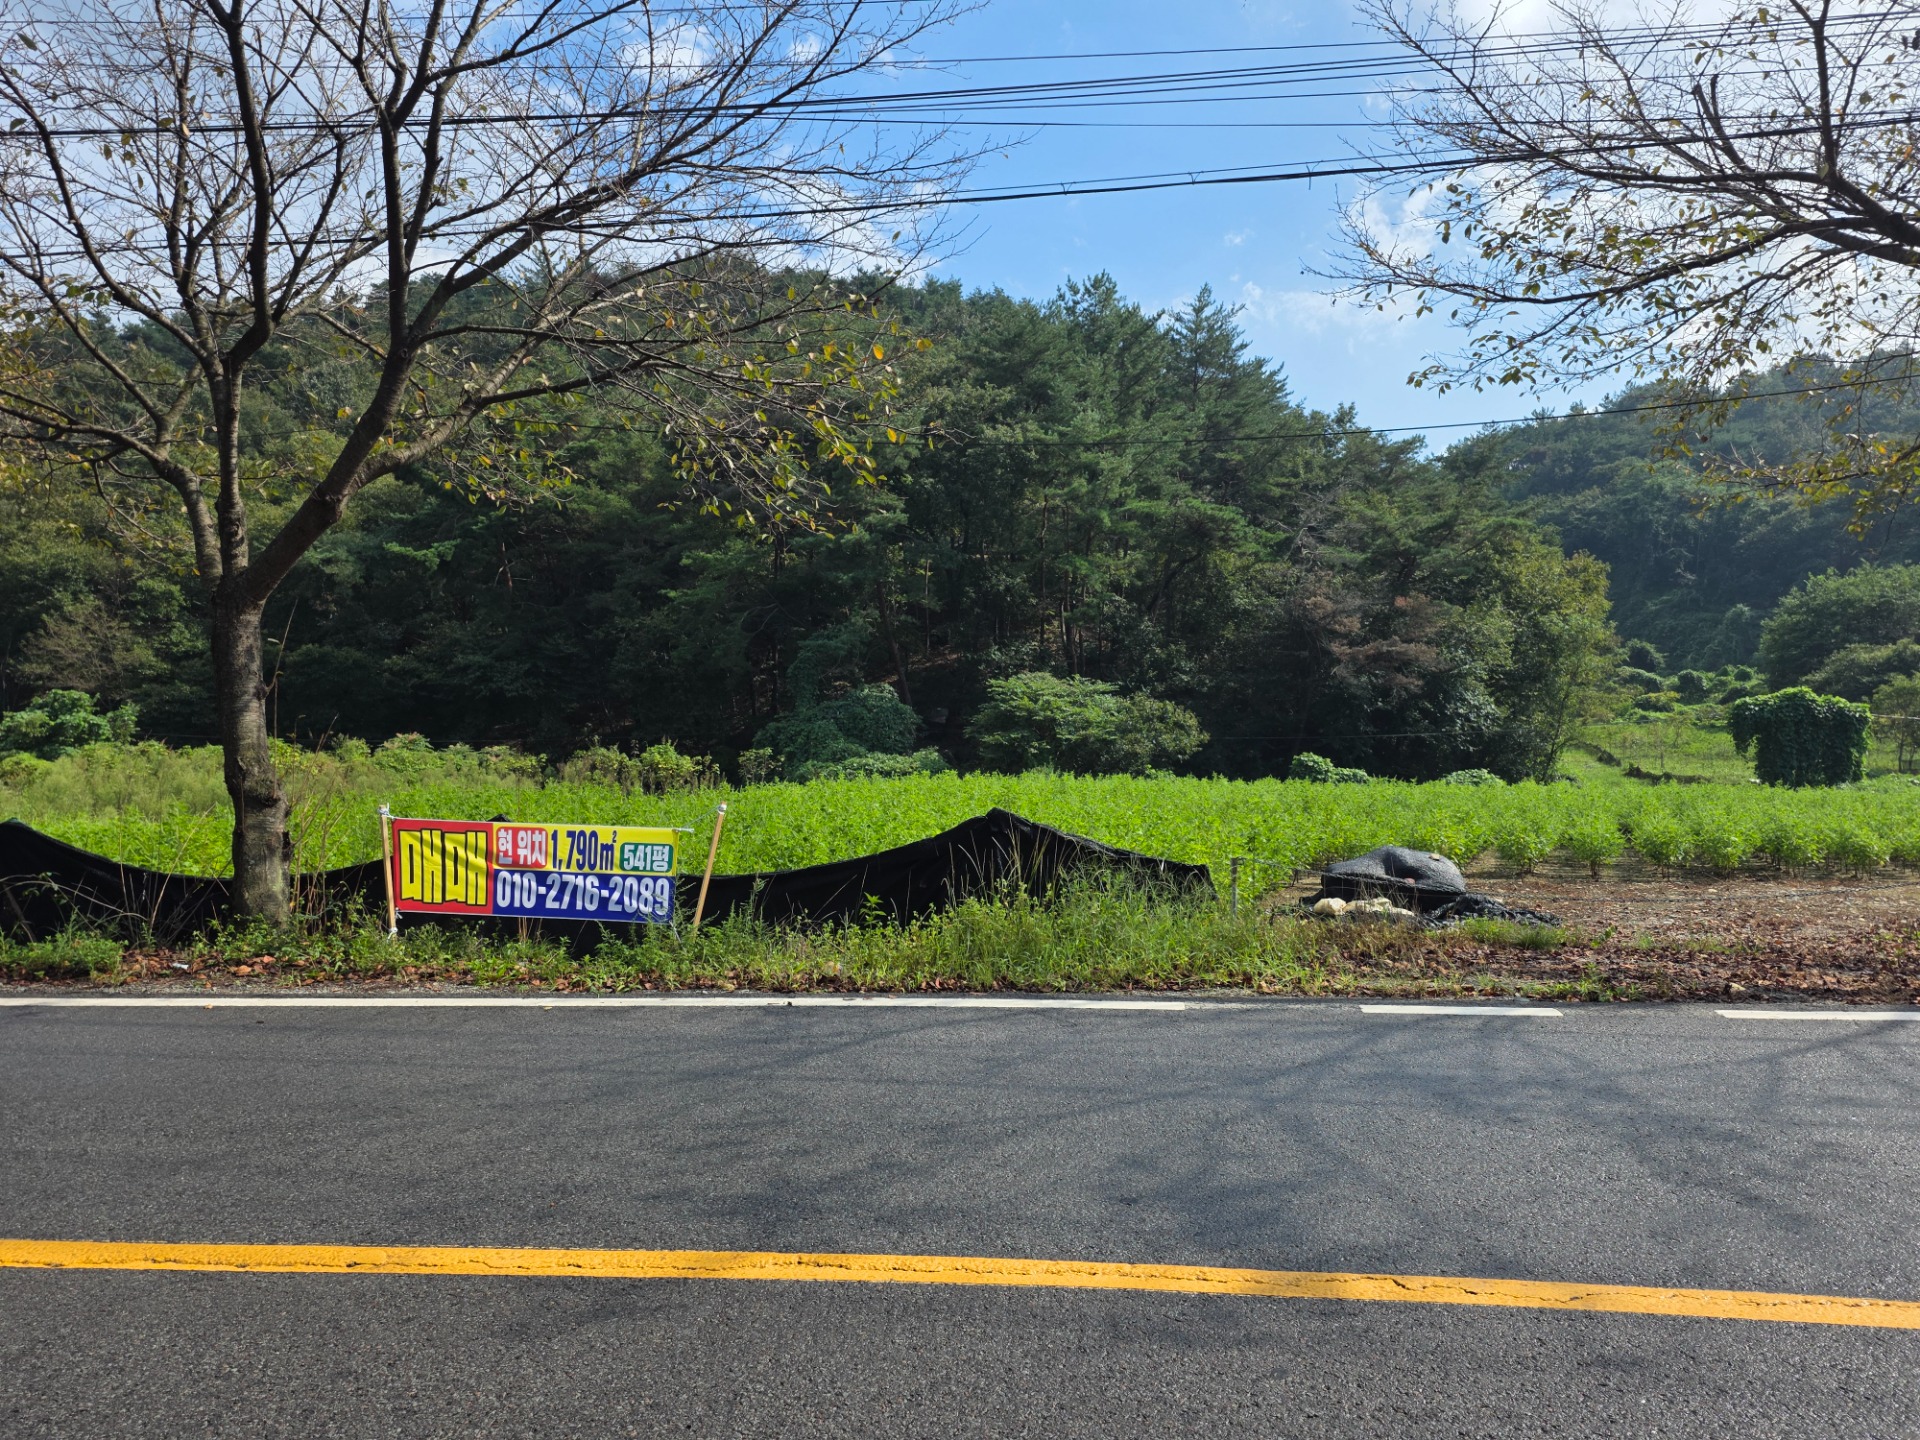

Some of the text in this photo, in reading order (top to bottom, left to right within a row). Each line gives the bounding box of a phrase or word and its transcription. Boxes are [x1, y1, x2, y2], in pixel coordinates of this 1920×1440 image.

[398, 828, 488, 907] 매매
[497, 828, 548, 867] 현 위치
[623, 844, 671, 873] 541평
[496, 871, 671, 916] 010-2716-2089
